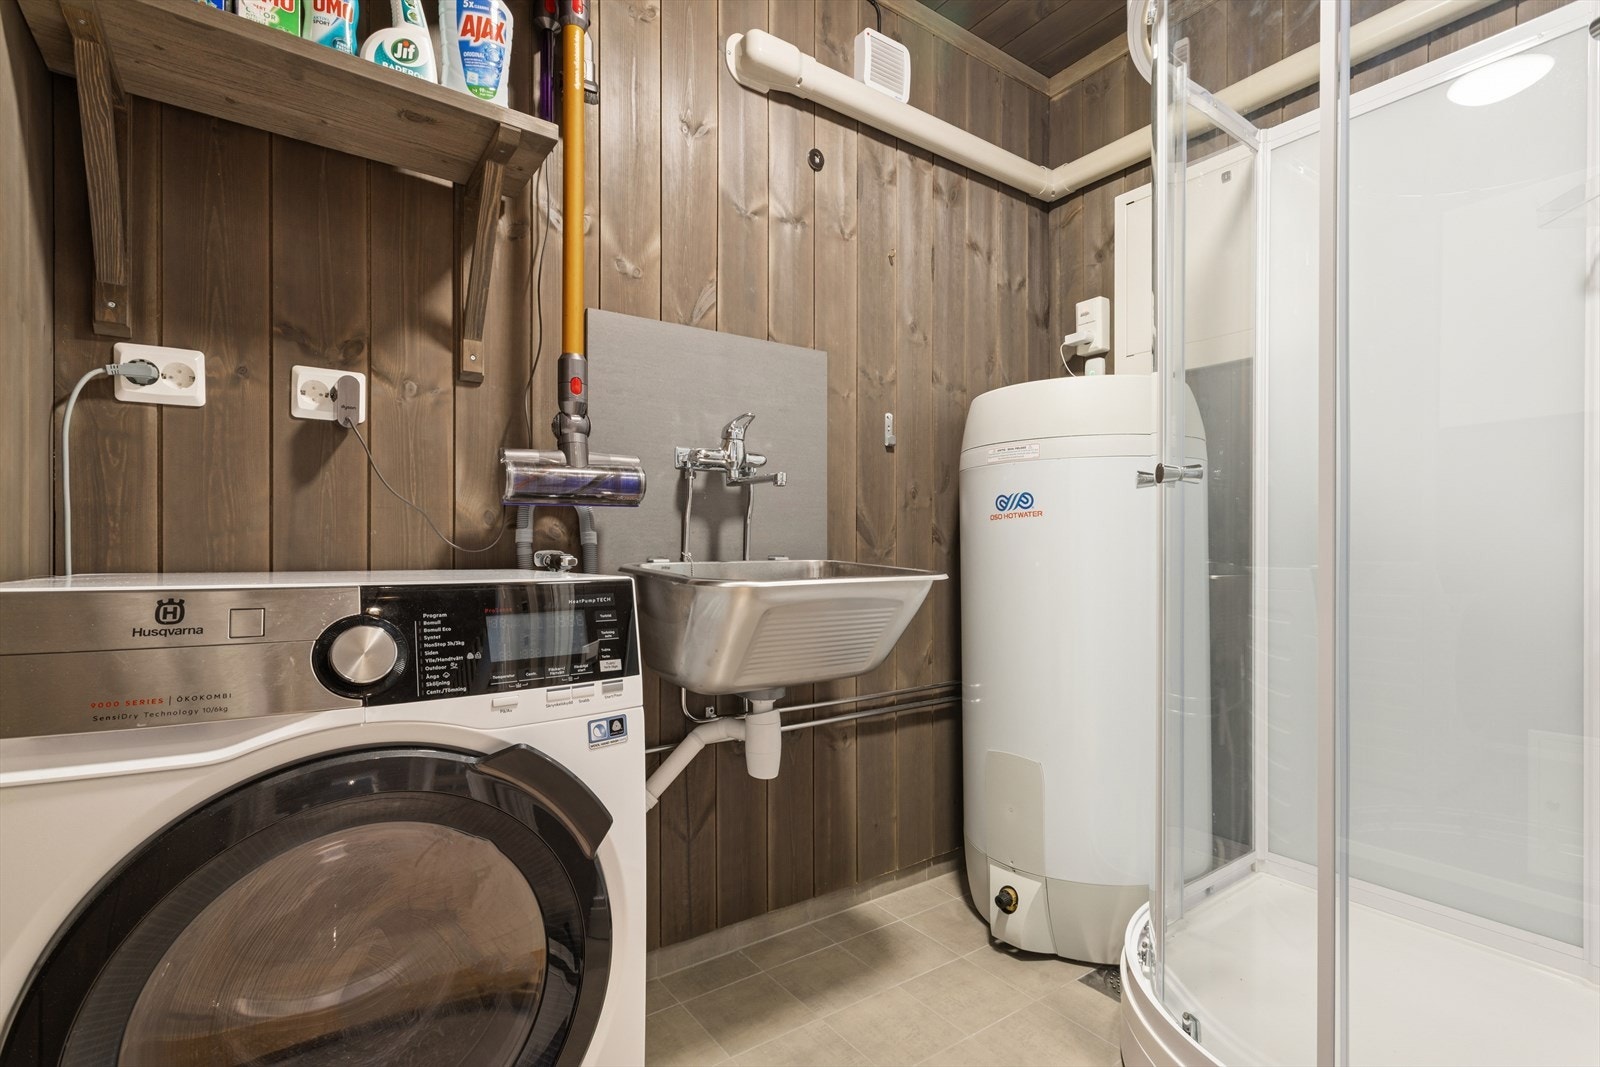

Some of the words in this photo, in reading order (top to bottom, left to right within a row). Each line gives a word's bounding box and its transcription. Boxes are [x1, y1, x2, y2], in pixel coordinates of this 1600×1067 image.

[460, 14, 505, 44] AJAX
[394, 40, 415, 59] Jif
[1003, 510, 1043, 519] HOTWATER
[132, 626, 204, 638] Husqvarna
[426, 686, 467, 695] Centr./Tömning
[90, 700, 120, 709] 9000
[125, 697, 164, 706] SERIES
[176, 692, 232, 702] ÖKOKOMBI
[92, 713, 138, 722] SensiDry
[144, 708, 199, 718] Technology
[202, 705, 228, 714] 10/6kg
